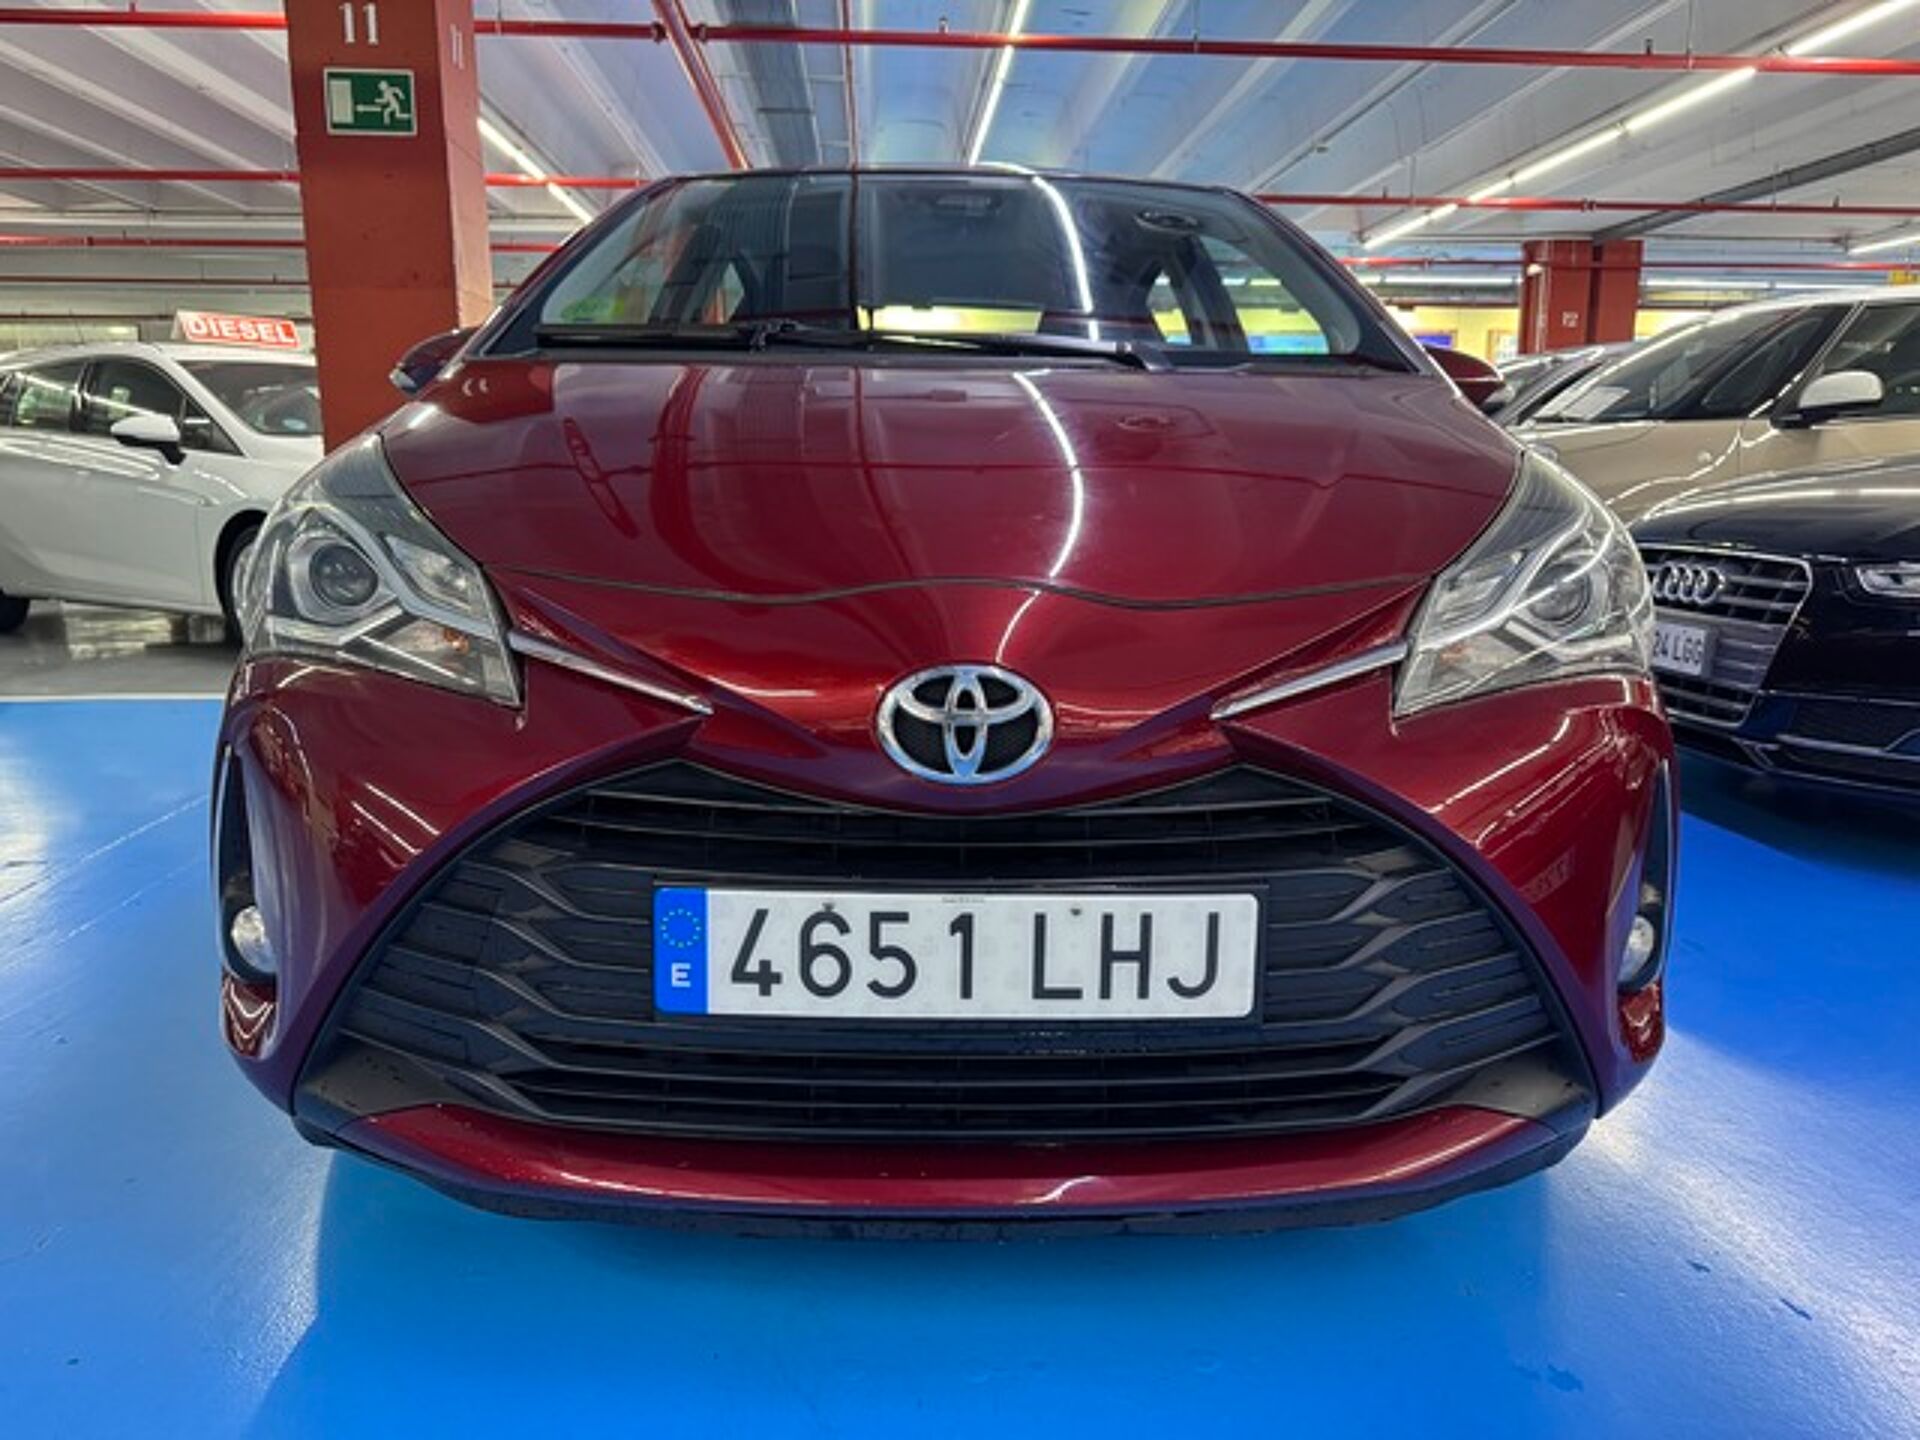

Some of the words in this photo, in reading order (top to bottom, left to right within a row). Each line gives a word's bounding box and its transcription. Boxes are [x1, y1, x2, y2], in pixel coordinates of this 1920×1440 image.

[339, 2, 379, 45] 11
[188, 317, 296, 344] DIESEL
[1652, 629, 1668, 657] 24
[670, 962, 692, 988] E
[730, 908, 975, 1000] 4651
[1032, 911, 1220, 1001] LHJ
